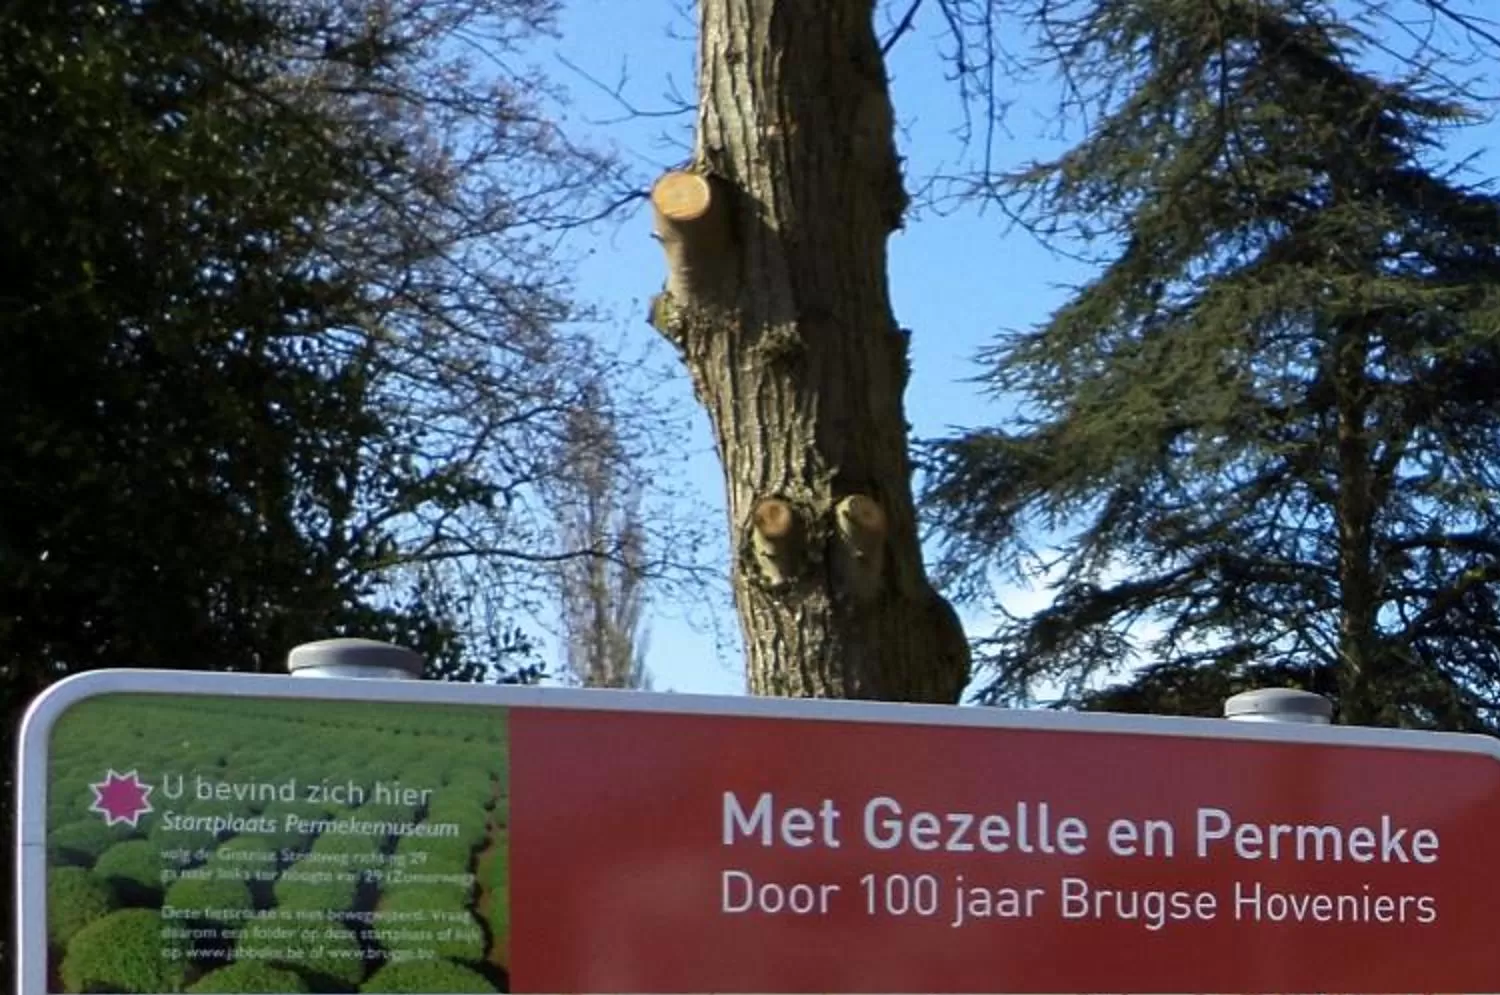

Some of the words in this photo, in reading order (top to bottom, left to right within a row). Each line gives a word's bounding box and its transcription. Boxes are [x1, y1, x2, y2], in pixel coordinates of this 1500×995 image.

[162, 775, 183, 800] U
[196, 776, 297, 802] bevind
[306, 778, 364, 804] zich
[375, 781, 433, 806] hier
[161, 811, 277, 837] Startplaats
[284, 813, 460, 839] Permekemuseum
[721, 790, 841, 849] Met
[863, 796, 1089, 856] Gezelle
[1107, 816, 1175, 859] en
[1196, 807, 1440, 865] Permeke
[720, 869, 841, 914] Door
[859, 872, 939, 916] 100
[951, 874, 1045, 928] jaar
[1060, 877, 1217, 931] Brugse
[1234, 882, 1438, 924] Hoveniers
